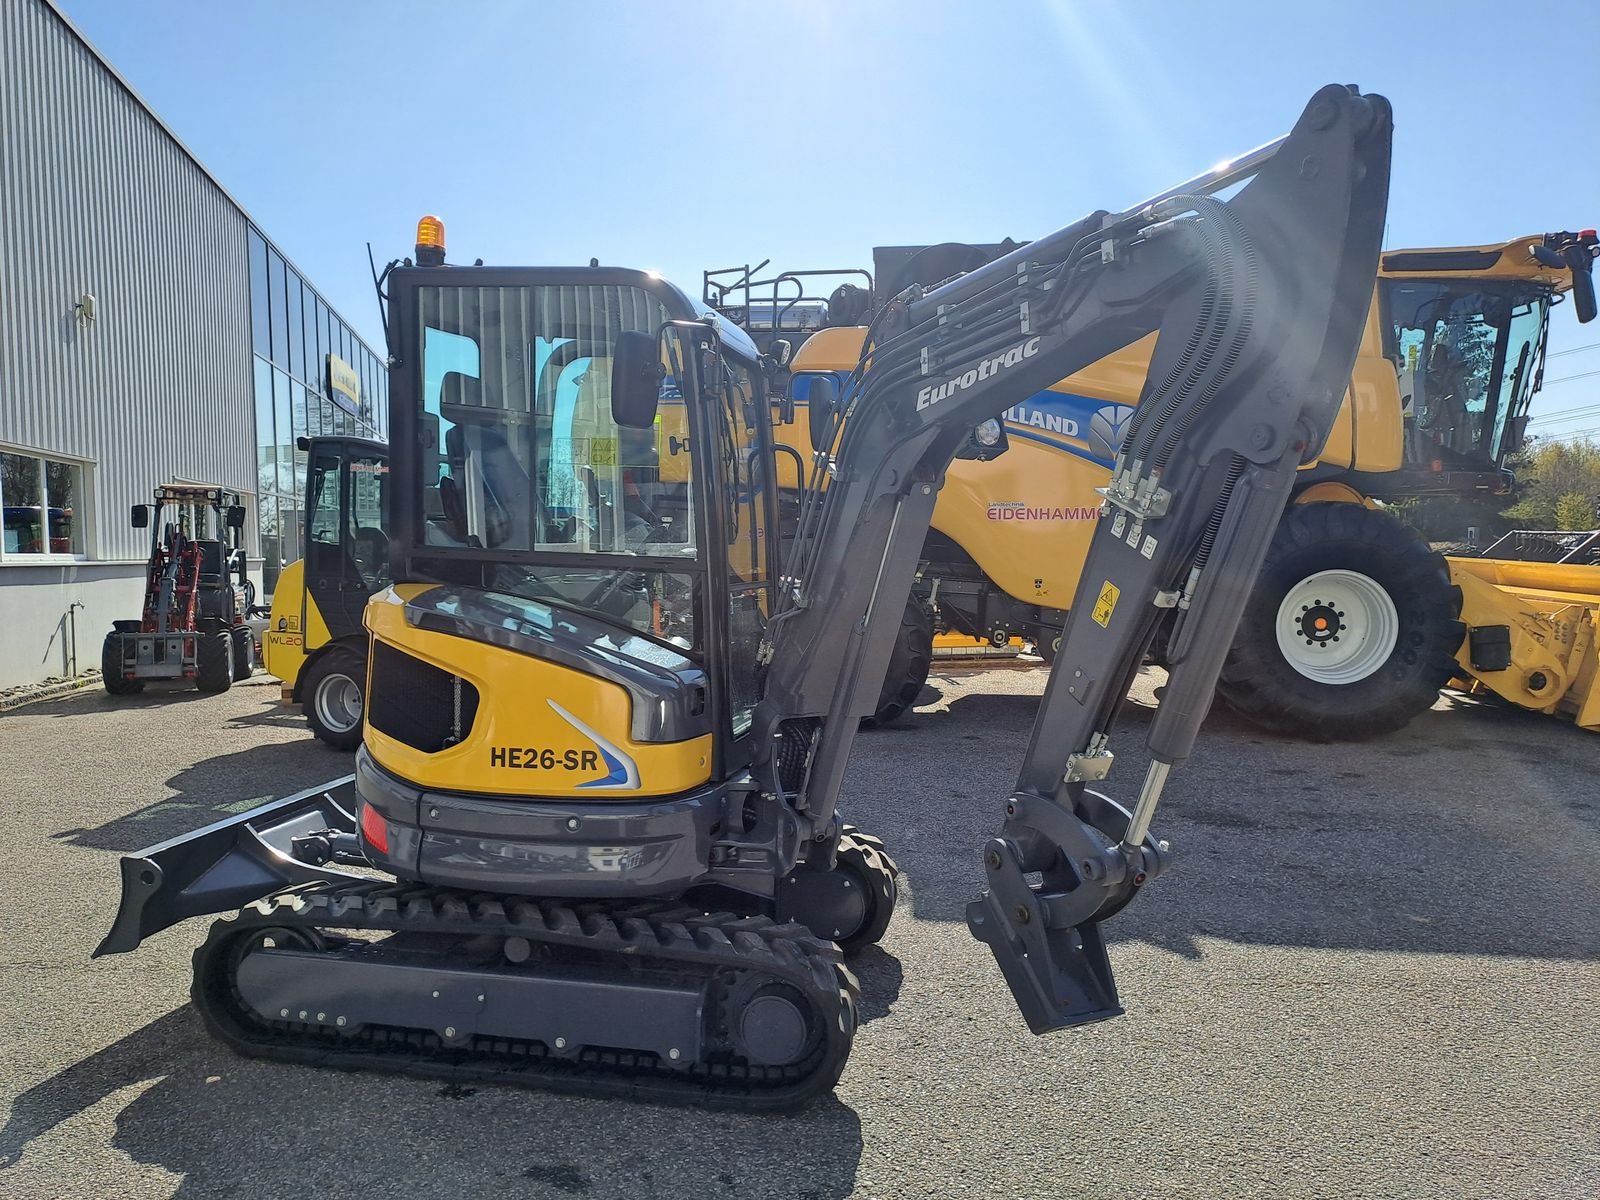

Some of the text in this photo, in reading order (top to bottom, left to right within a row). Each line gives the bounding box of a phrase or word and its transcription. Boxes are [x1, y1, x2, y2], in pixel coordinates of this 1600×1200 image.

[916, 335, 1041, 412] Eurotrac
[1002, 405, 1079, 437] LLAND
[270, 636, 302, 646] WL20
[491, 747, 598, 771] HE26-SR
